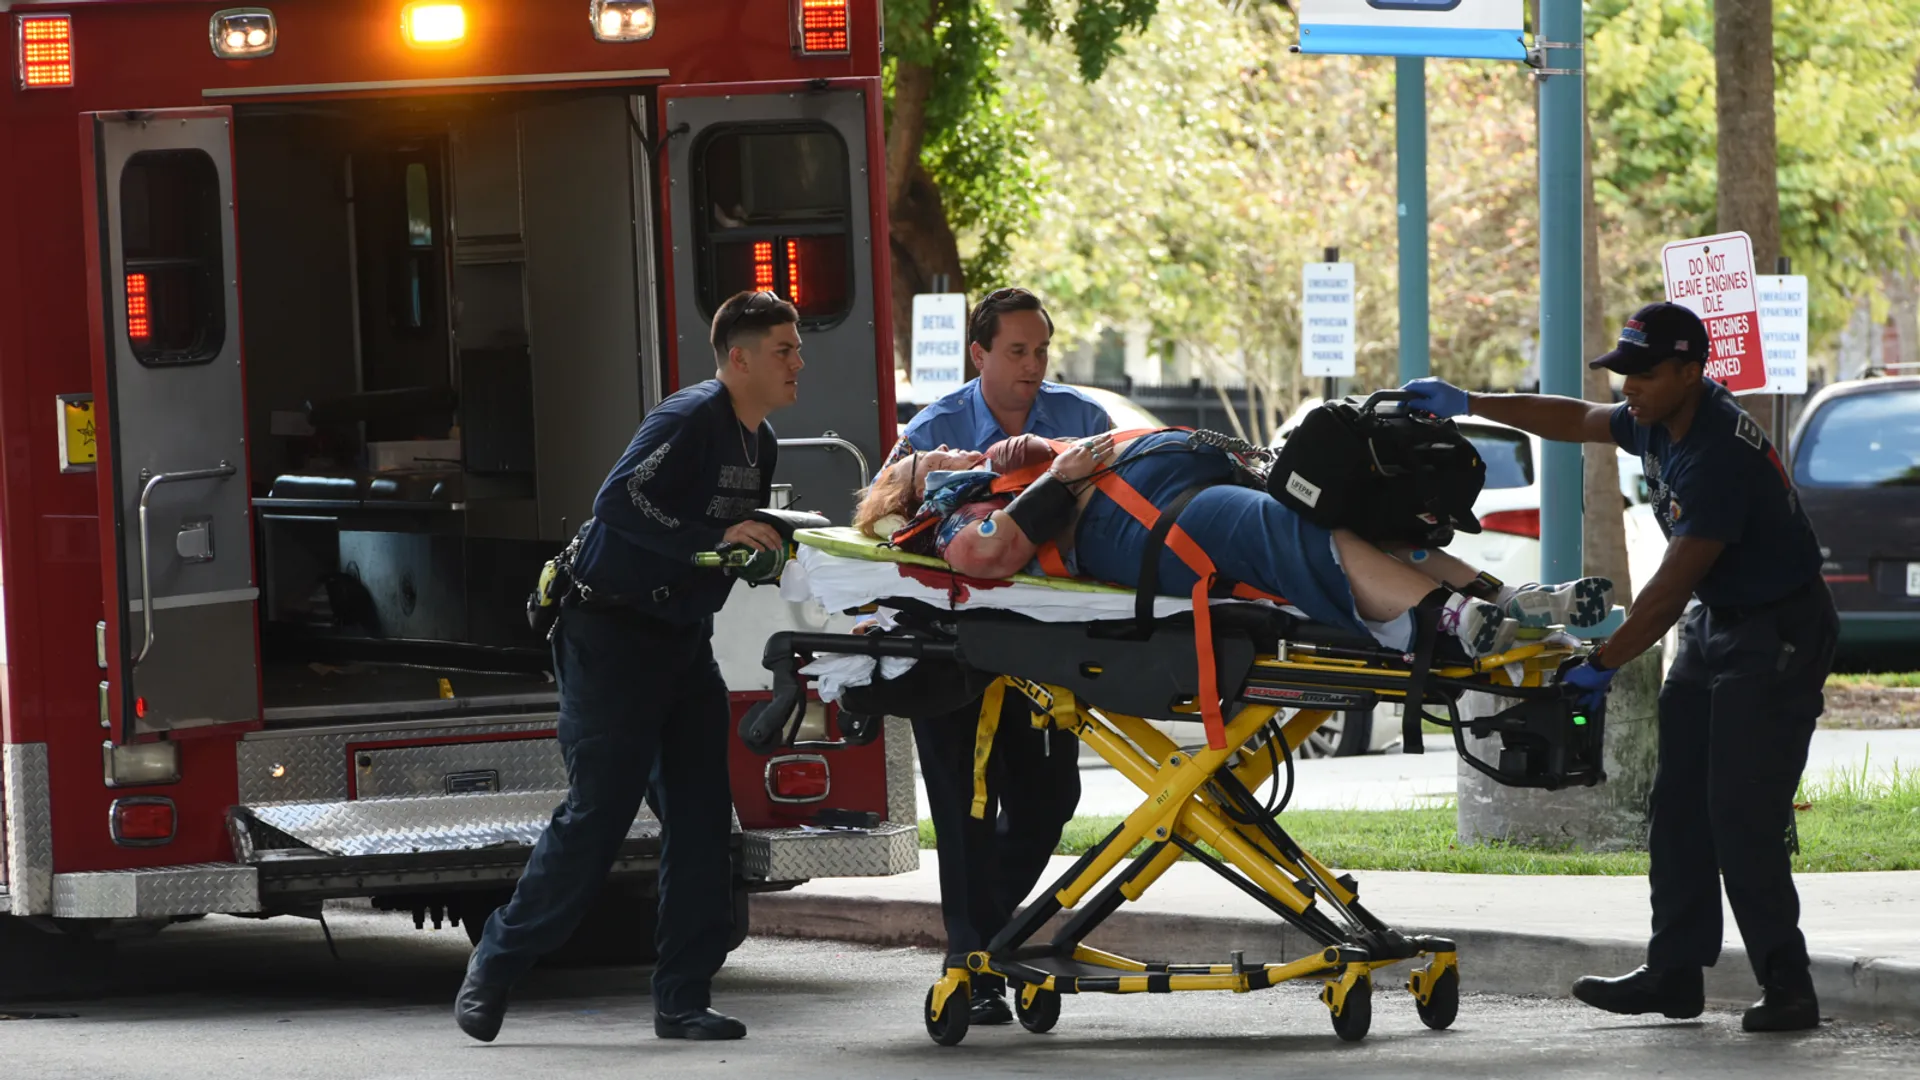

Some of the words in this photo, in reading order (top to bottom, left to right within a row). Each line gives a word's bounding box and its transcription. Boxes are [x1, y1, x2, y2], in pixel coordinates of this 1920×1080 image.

[1688, 257, 1704, 276] DO
[1706, 254, 1725, 273] NOT
[1673, 278, 1703, 298] LEAVE
[1705, 271, 1748, 293] ENGINES
[1306, 293, 1350, 303] DEPARTMENT
[1702, 294, 1724, 313] IDLE
[922, 314, 955, 330] DETAIL
[1308, 317, 1348, 327] PHYSICIAN
[1710, 315, 1750, 338] ENGINES
[1763, 332, 1800, 342] HYSICIAN
[916, 340, 960, 356] OFFICER
[1714, 336, 1746, 358] WHILE
[1767, 349, 1796, 359] ONSULT
[1768, 366, 1796, 377] ARKING
[1156, 789, 1169, 805] R17
